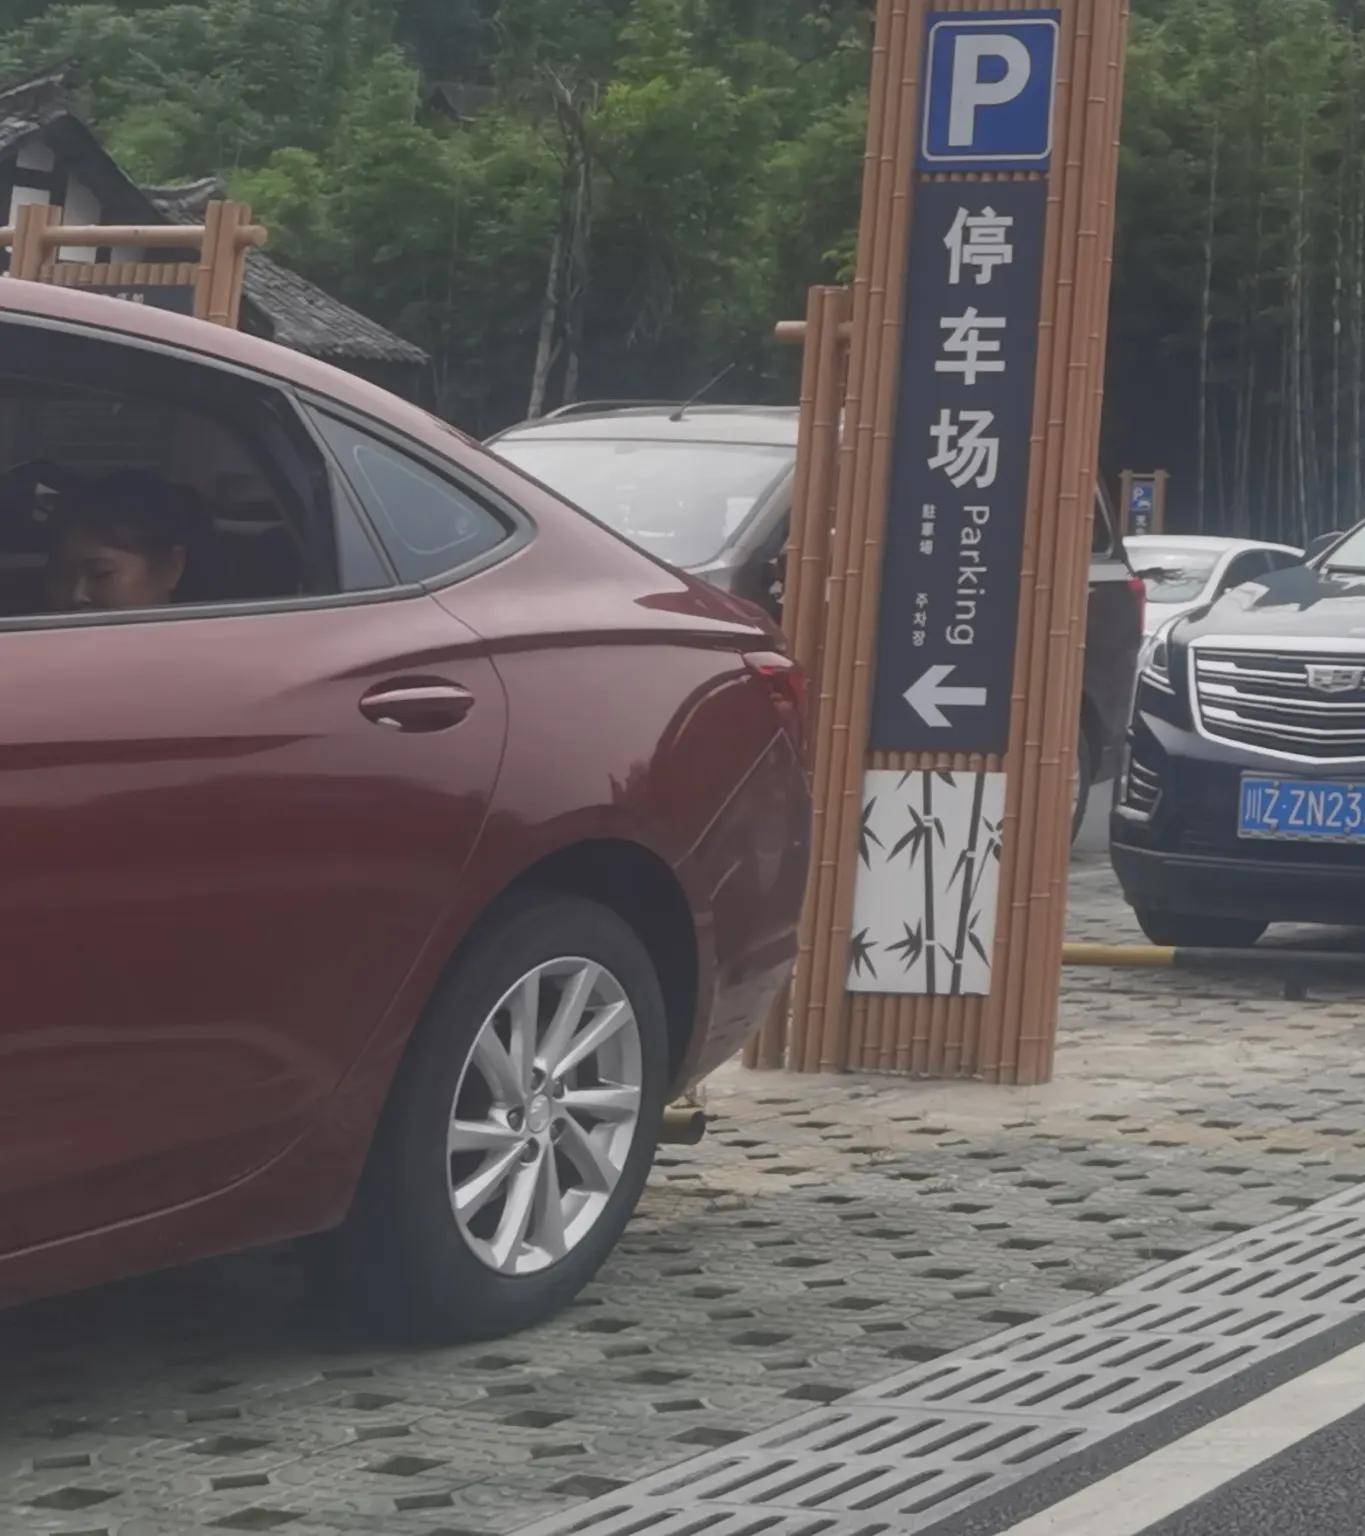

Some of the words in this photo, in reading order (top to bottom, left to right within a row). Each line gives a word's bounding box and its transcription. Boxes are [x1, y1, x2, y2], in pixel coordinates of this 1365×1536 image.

[948, 33, 1031, 147] P
[927, 205, 1014, 490] 停车场
[945, 505, 990, 646] Parking
